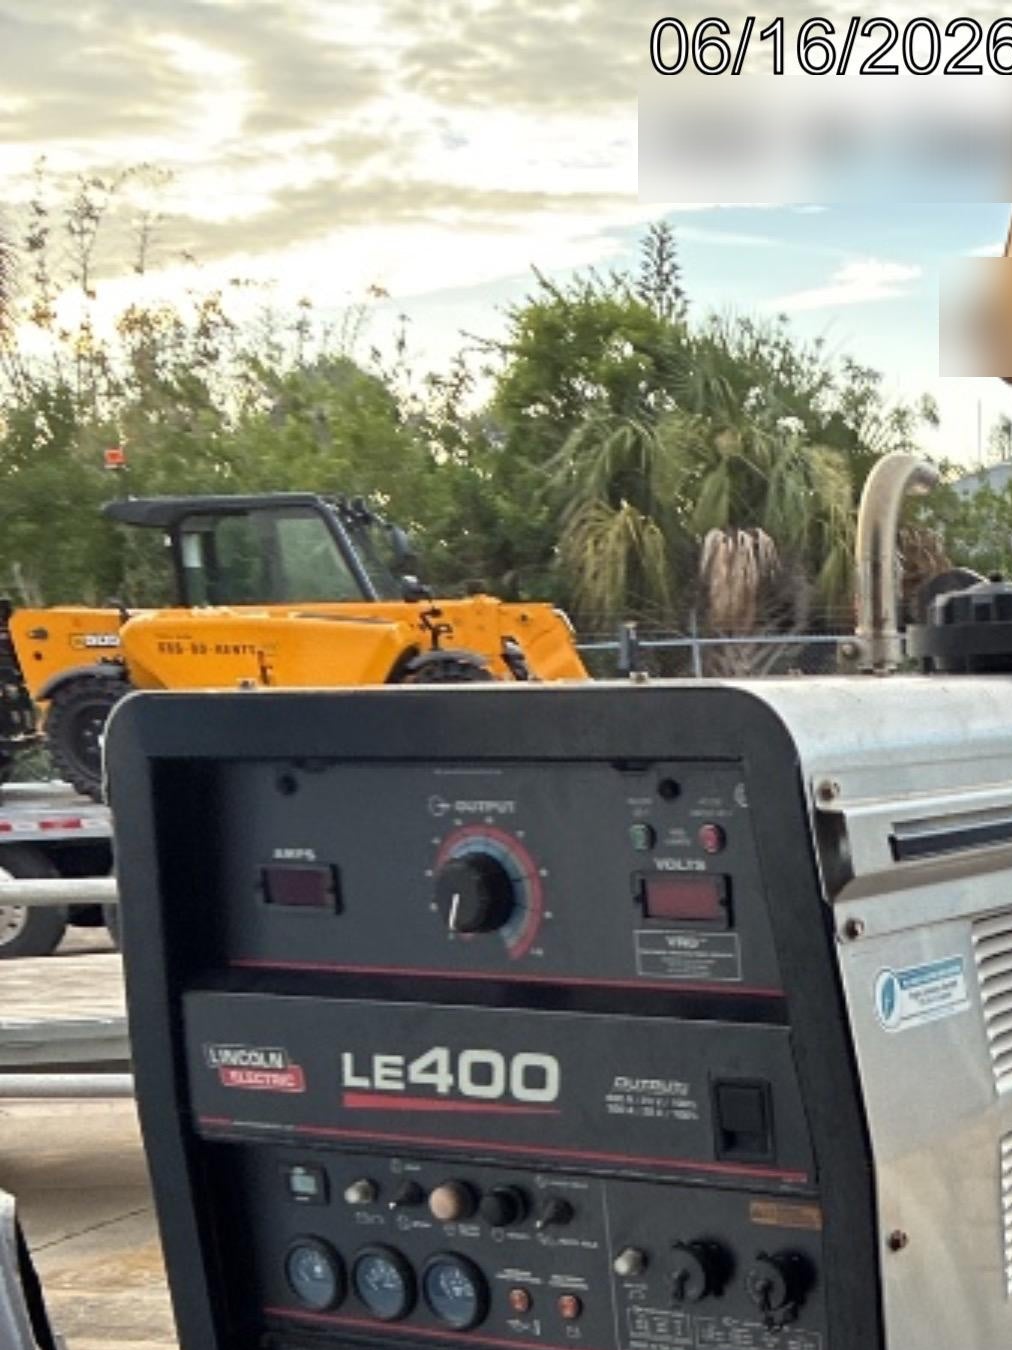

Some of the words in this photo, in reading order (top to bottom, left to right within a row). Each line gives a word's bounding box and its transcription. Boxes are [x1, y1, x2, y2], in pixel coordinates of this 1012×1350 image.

[455, 800, 516, 814] OUTPUT
[271, 848, 317, 861] AMPS
[653, 858, 706, 871] VOLTS
[208, 1048, 286, 1070] LINCOLN
[229, 1070, 295, 1088] ELECTRIC
[341, 1046, 561, 1103] LE400
